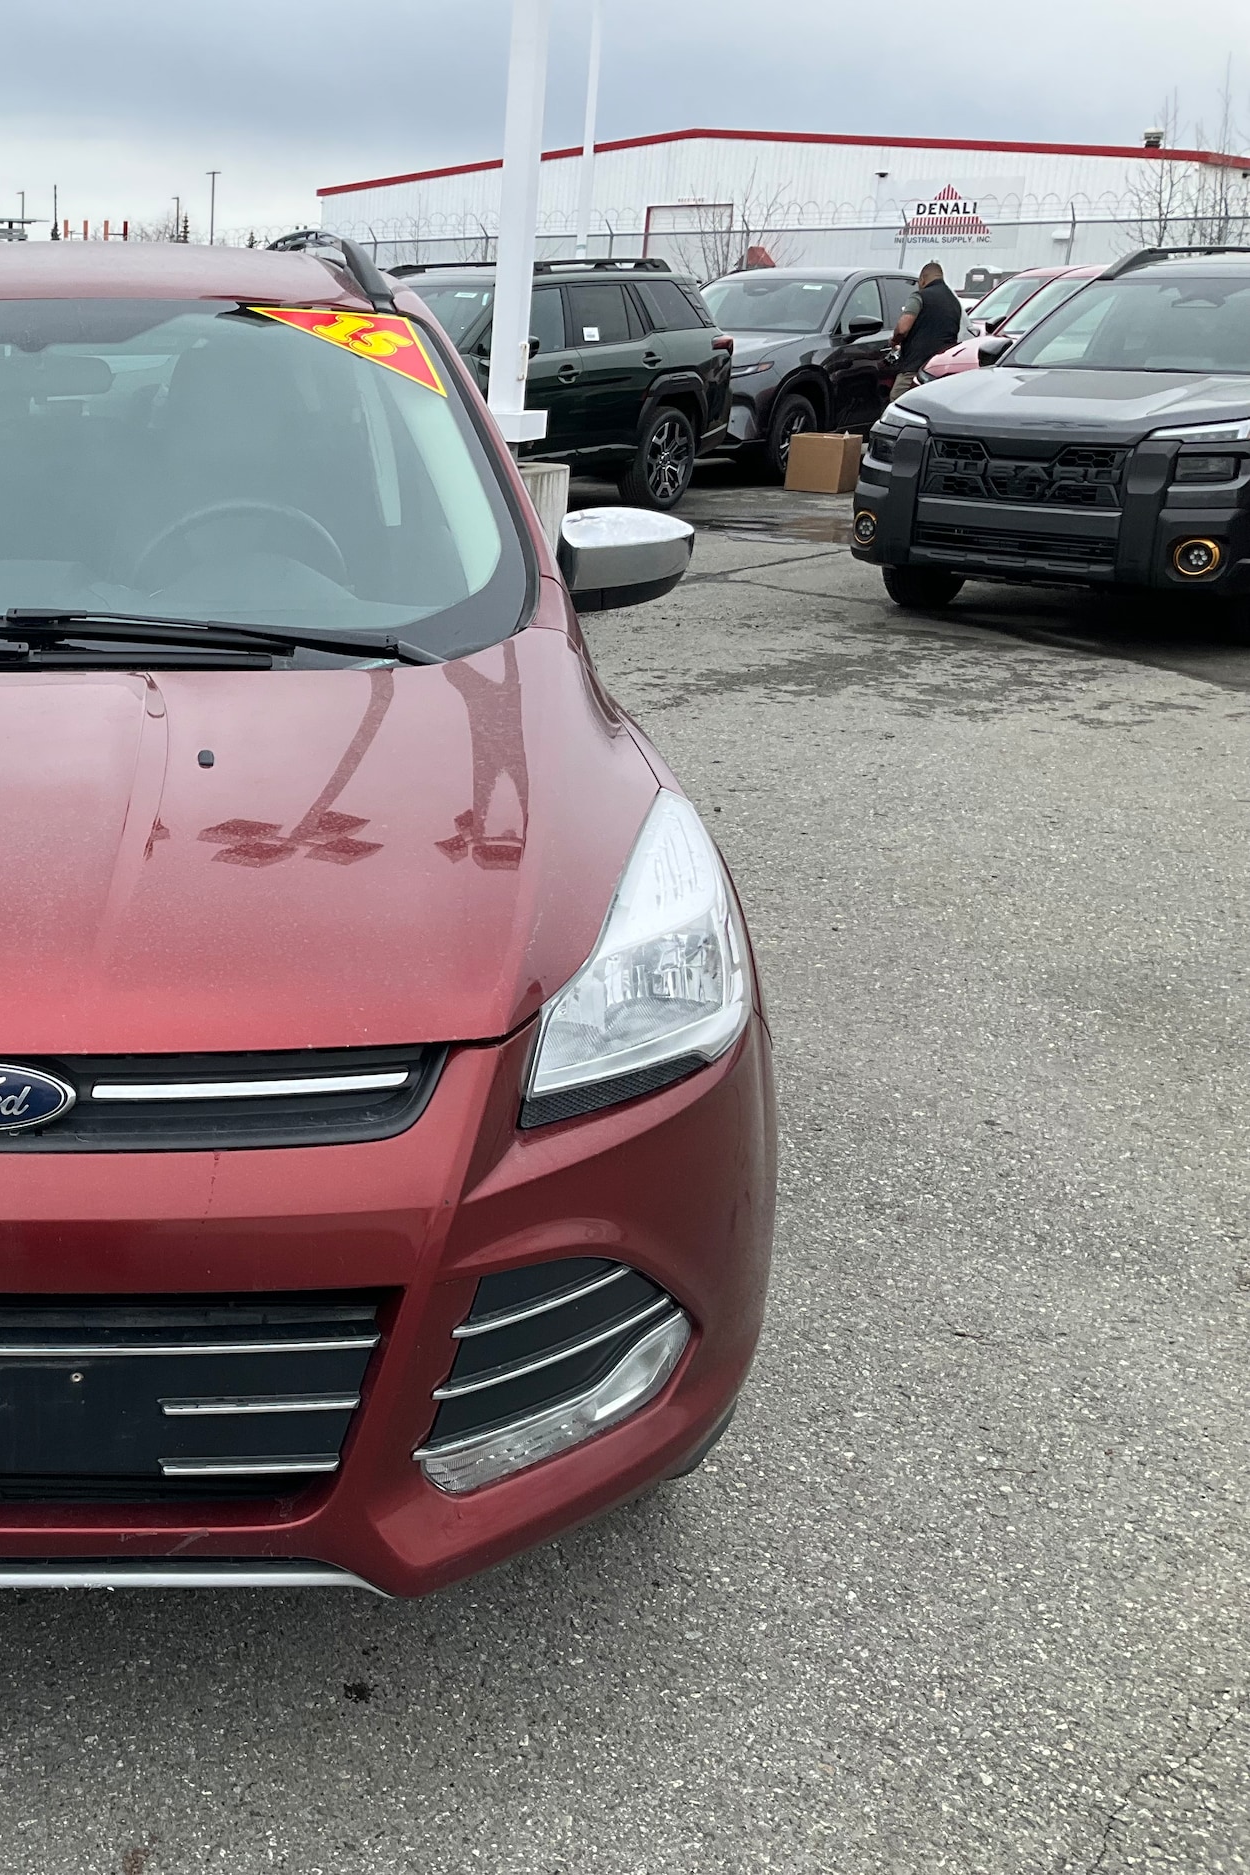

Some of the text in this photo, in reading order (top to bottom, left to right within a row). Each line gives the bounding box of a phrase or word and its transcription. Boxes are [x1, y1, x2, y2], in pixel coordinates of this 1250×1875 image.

[916, 202, 977, 215] DENALI
[941, 235, 974, 244] SUPPLY,
[976, 235, 992, 243] INC.
